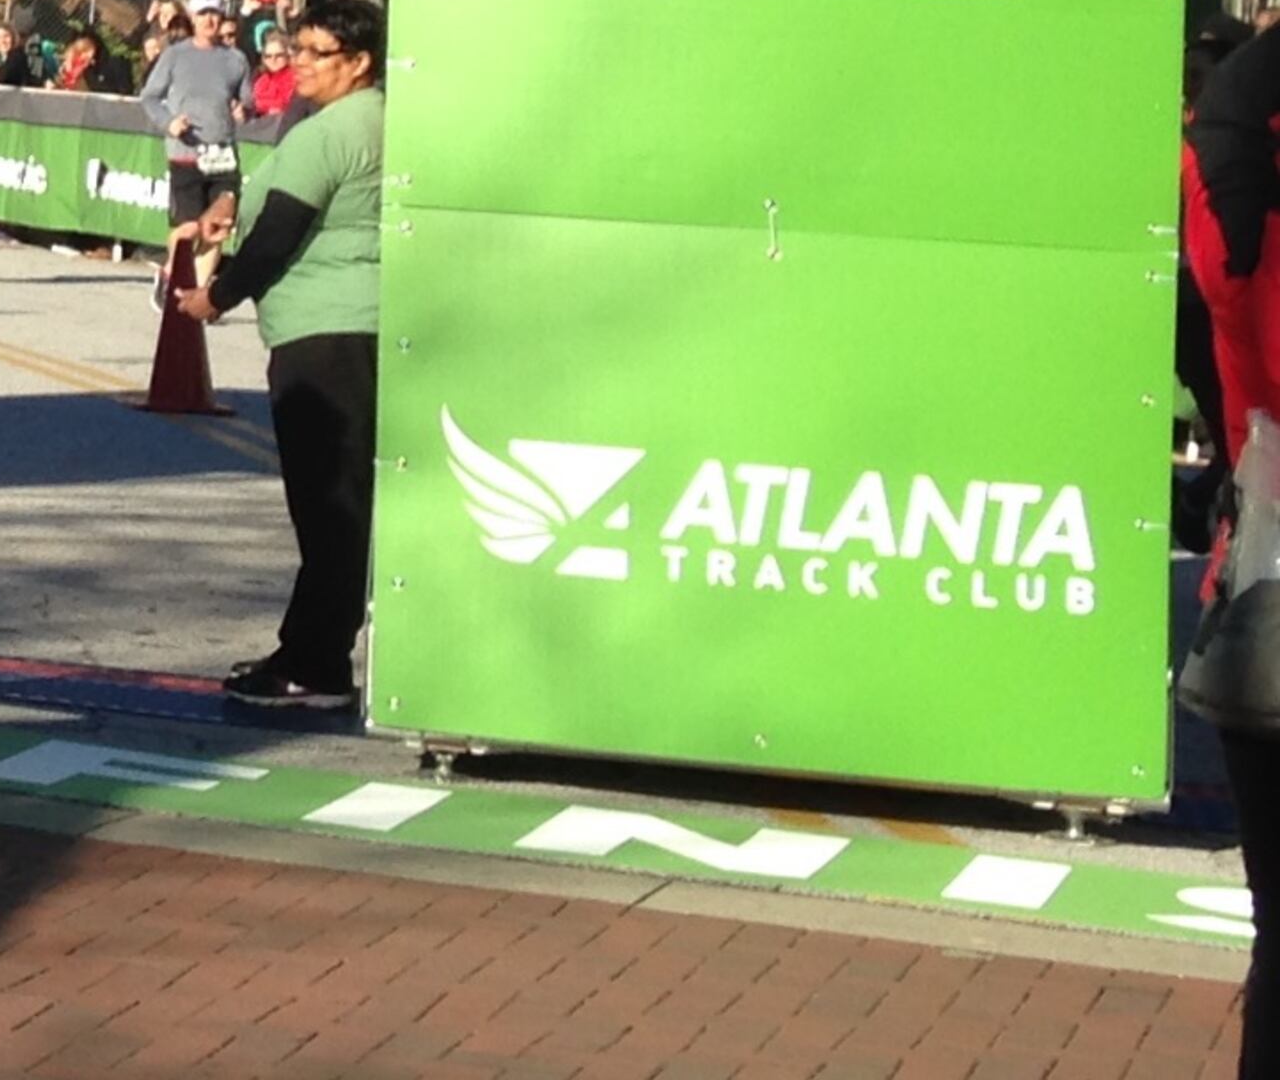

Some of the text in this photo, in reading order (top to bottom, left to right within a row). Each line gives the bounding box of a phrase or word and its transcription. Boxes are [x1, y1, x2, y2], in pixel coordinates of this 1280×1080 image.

[659, 458, 1096, 571] ATLANTA
[661, 544, 1096, 616] TRACK CLUB
